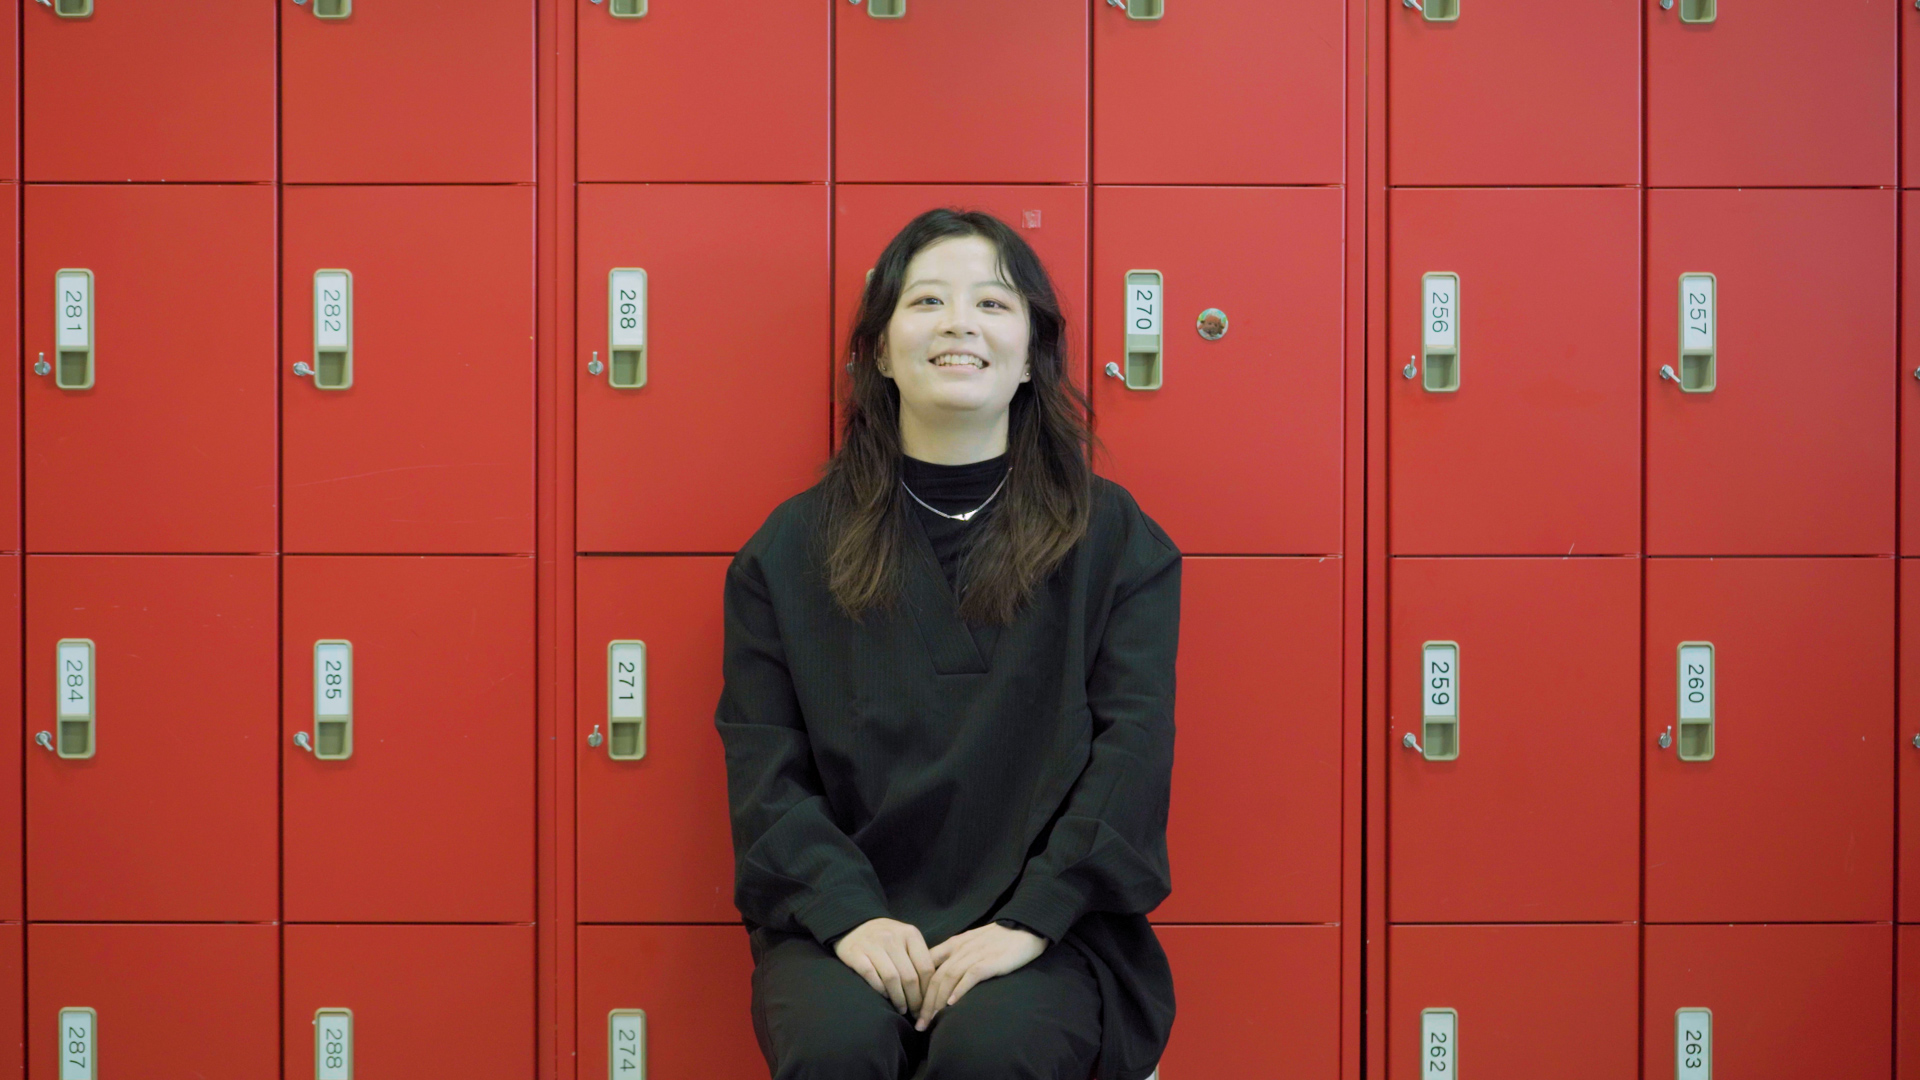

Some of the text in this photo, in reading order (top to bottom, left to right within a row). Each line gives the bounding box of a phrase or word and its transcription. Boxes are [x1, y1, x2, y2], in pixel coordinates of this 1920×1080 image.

[65, 290, 83, 330] 281
[324, 289, 341, 332] 282
[620, 289, 637, 329] 268
[1135, 289, 1153, 330] 270
[1432, 292, 1449, 333] 256
[1689, 292, 1707, 335] 257
[66, 659, 84, 702] 284
[325, 660, 342, 700] 285
[618, 661, 635, 700] 271
[1431, 661, 1450, 706] 259
[1688, 664, 1705, 703] 260
[68, 1026, 86, 1069] 287
[325, 1028, 343, 1069] 288
[618, 1029, 636, 1072] 274
[1429, 1032, 1447, 1072] 262
[1685, 1029, 1702, 1069] 263
